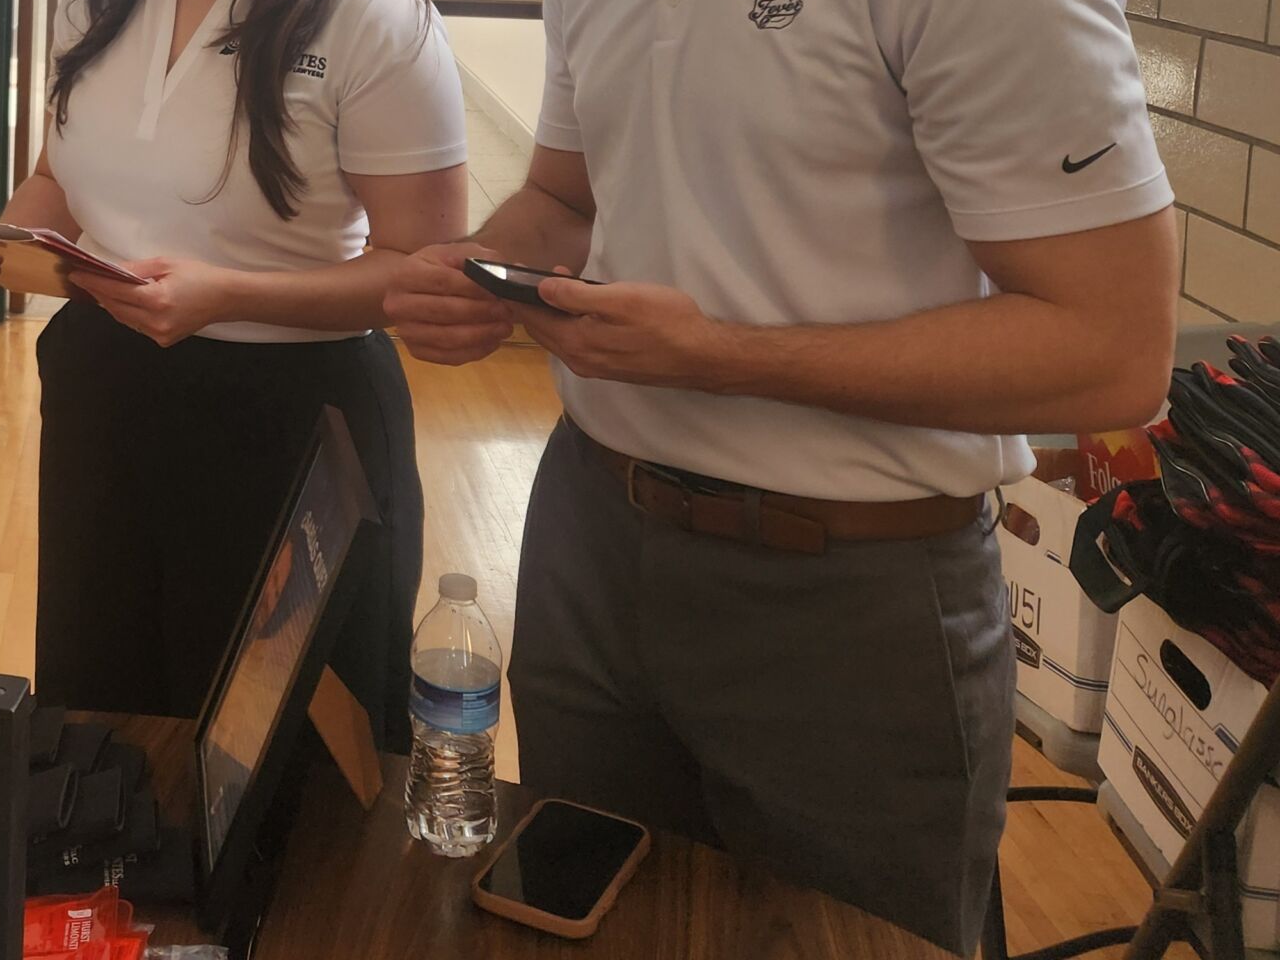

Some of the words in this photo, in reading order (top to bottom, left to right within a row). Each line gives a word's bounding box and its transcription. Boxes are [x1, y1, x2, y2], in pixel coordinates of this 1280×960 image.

[298, 54, 327, 71] TES
[1136, 756, 1174, 811] BANKERS
[1174, 806, 1193, 834] BOX
[80, 920, 91, 943] HURST
